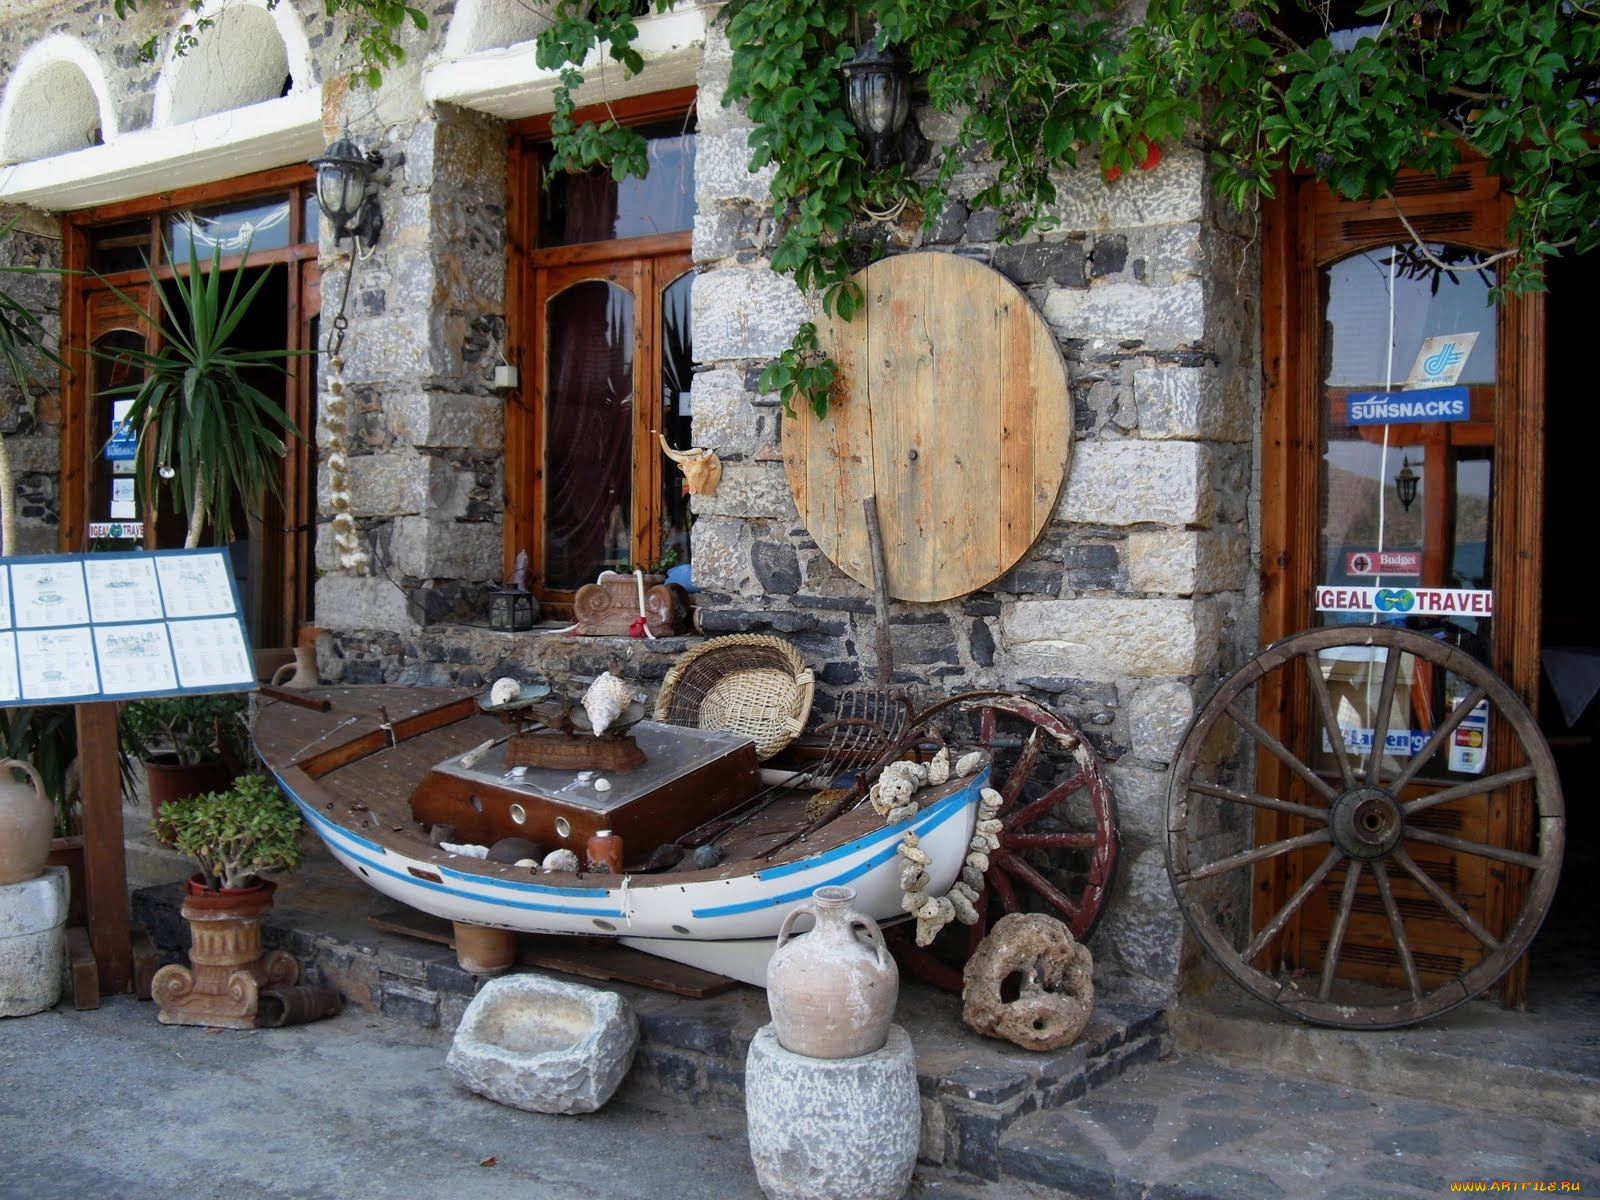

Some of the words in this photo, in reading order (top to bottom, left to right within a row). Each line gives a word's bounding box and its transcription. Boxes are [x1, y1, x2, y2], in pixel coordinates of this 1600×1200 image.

[1351, 400, 1464, 420] SUNSNACKS
[1380, 554, 1417, 566] Budget
[1416, 591, 1492, 612] TRAVEL
[1351, 729, 1409, 747] Laen
